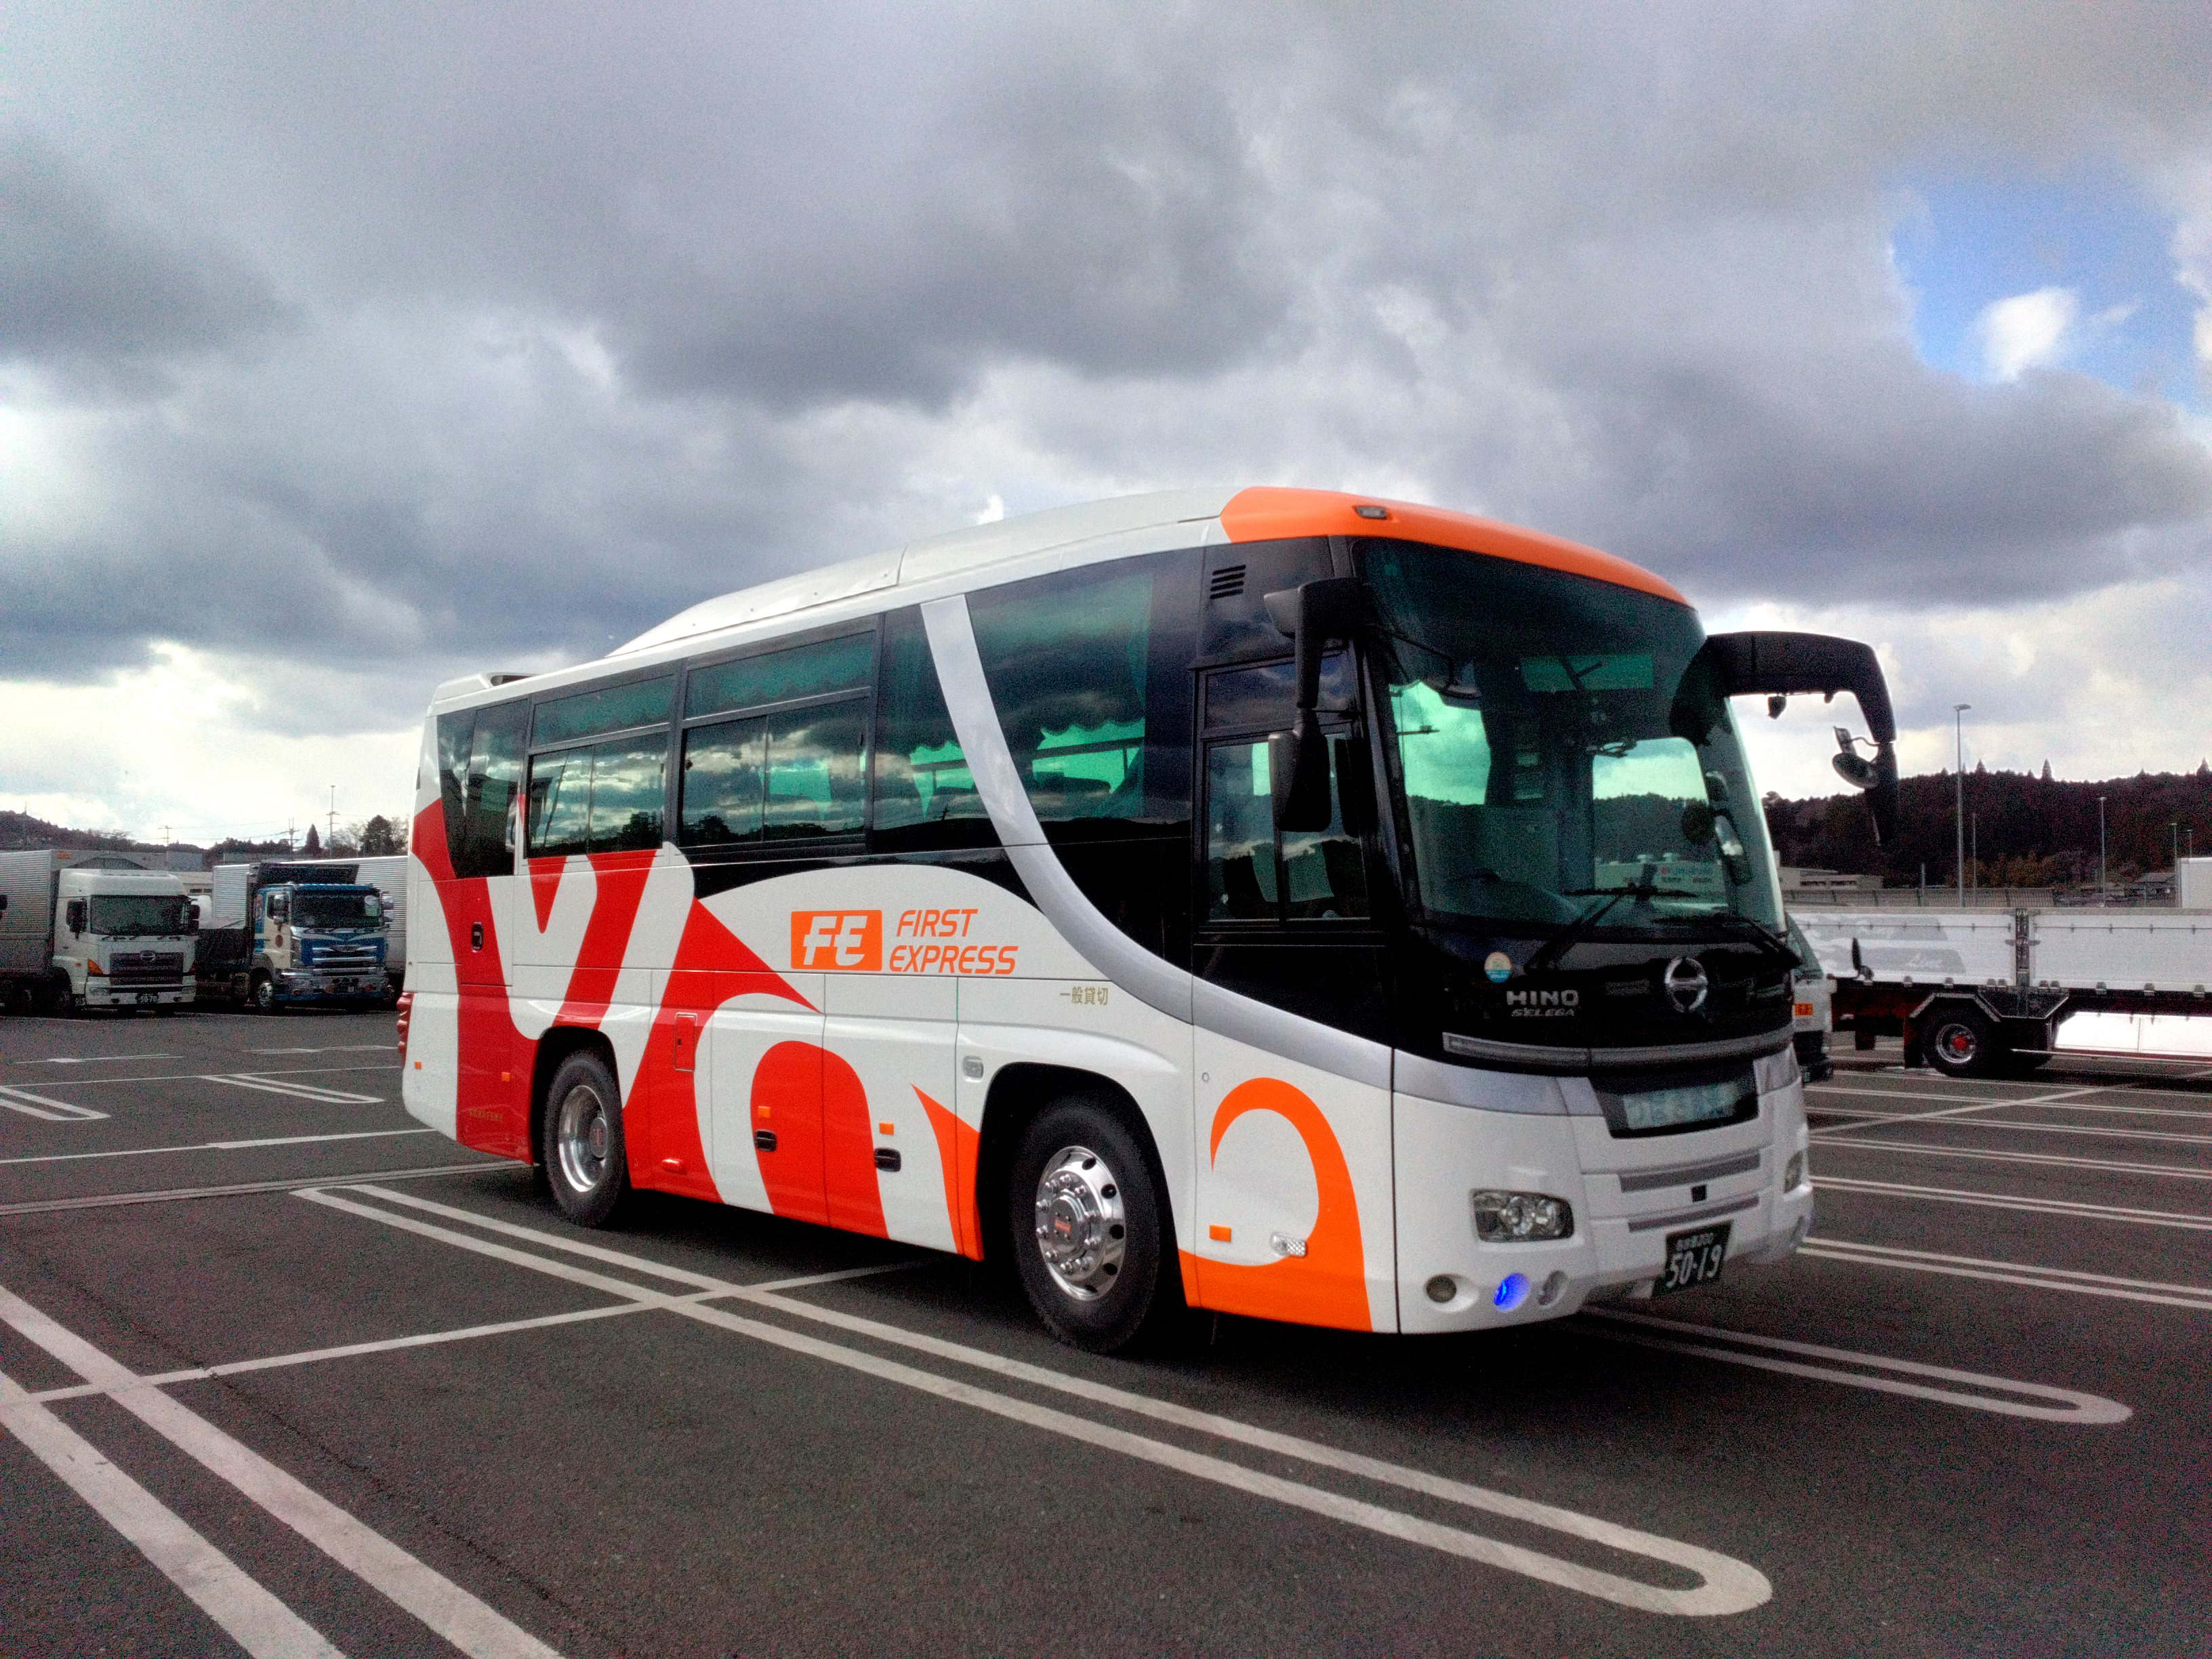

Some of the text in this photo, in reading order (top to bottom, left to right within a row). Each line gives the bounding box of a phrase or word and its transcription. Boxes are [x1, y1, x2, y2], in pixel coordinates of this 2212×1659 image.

[896, 909, 979, 937] FIRST
[802, 916, 868, 966] FE
[889, 945, 1019, 975] EXPRESS
[1059, 985, 1109, 1006] 一般貸切
[1506, 989, 1579, 1006] HINO
[1666, 1244, 1723, 1288] 50-19
